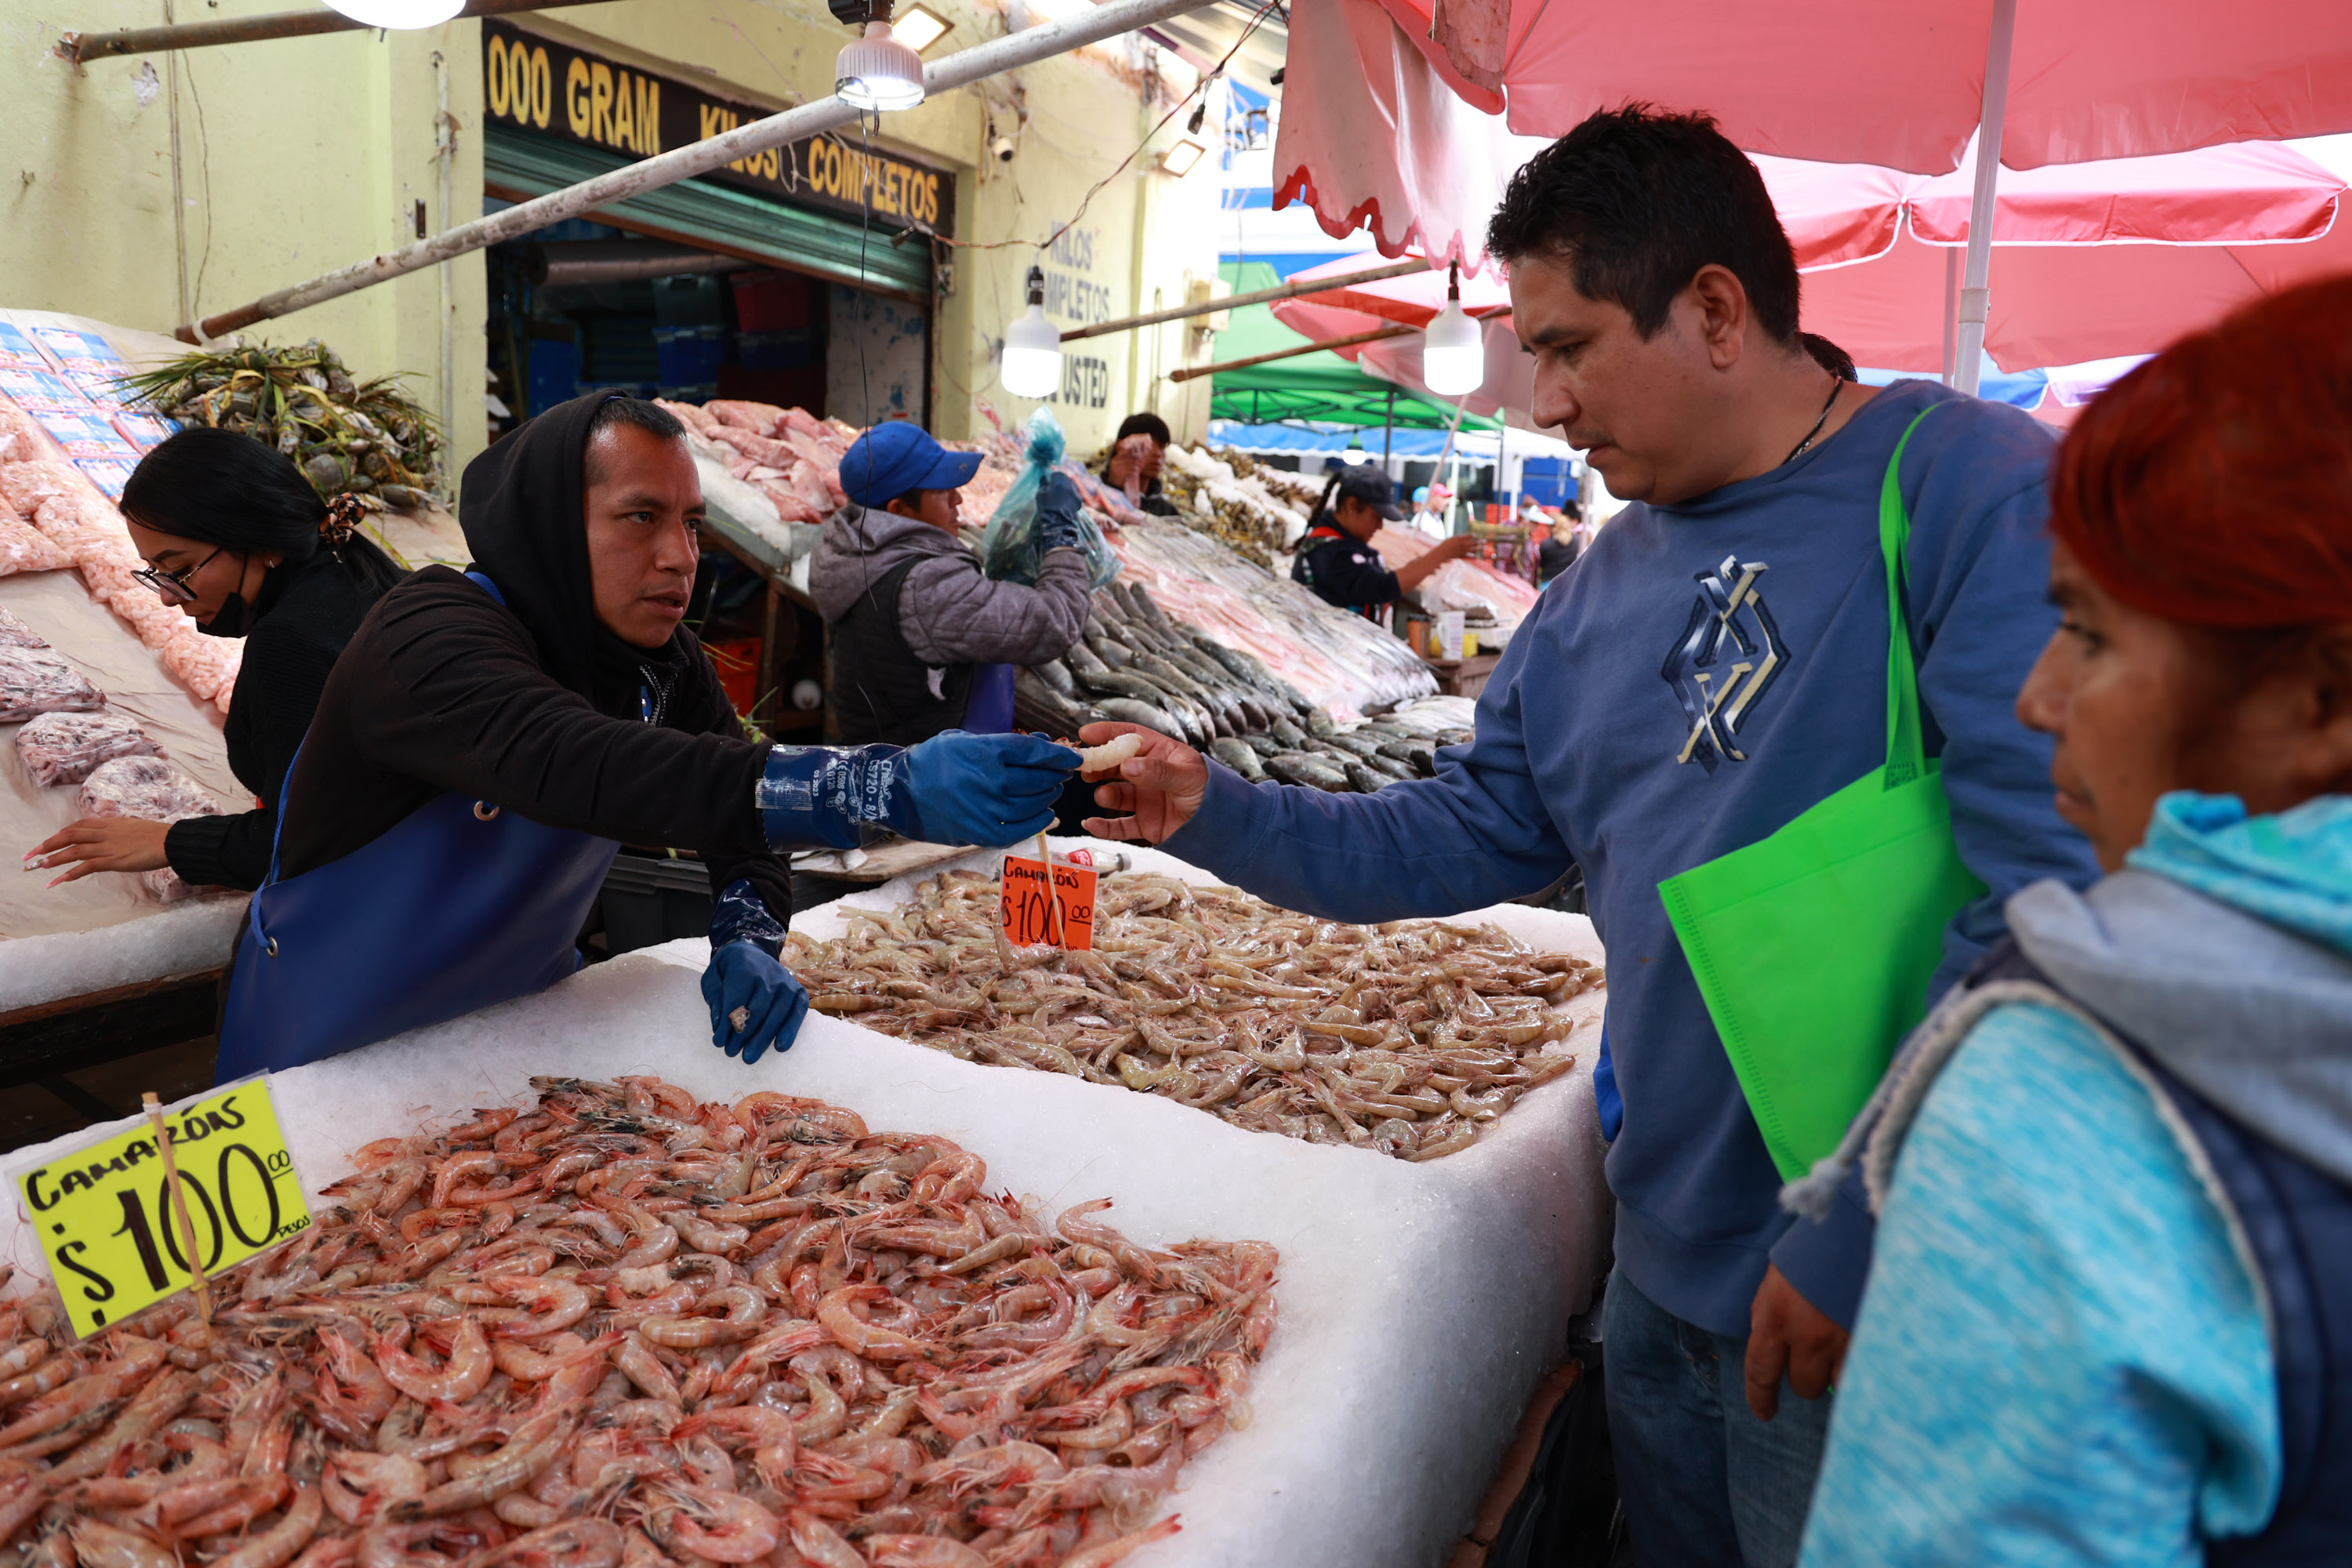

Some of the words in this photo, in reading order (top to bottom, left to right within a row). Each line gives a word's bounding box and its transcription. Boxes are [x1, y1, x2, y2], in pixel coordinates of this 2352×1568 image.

[483, 34, 552, 130] 000
[566, 56, 661, 157] GRAM
[808, 137, 938, 225] COMPLETOS
[1024, 265, 1110, 322] CMPLETOS
[1062, 354, 1108, 408] USTED
[277, 1215, 310, 1238] PESOS
